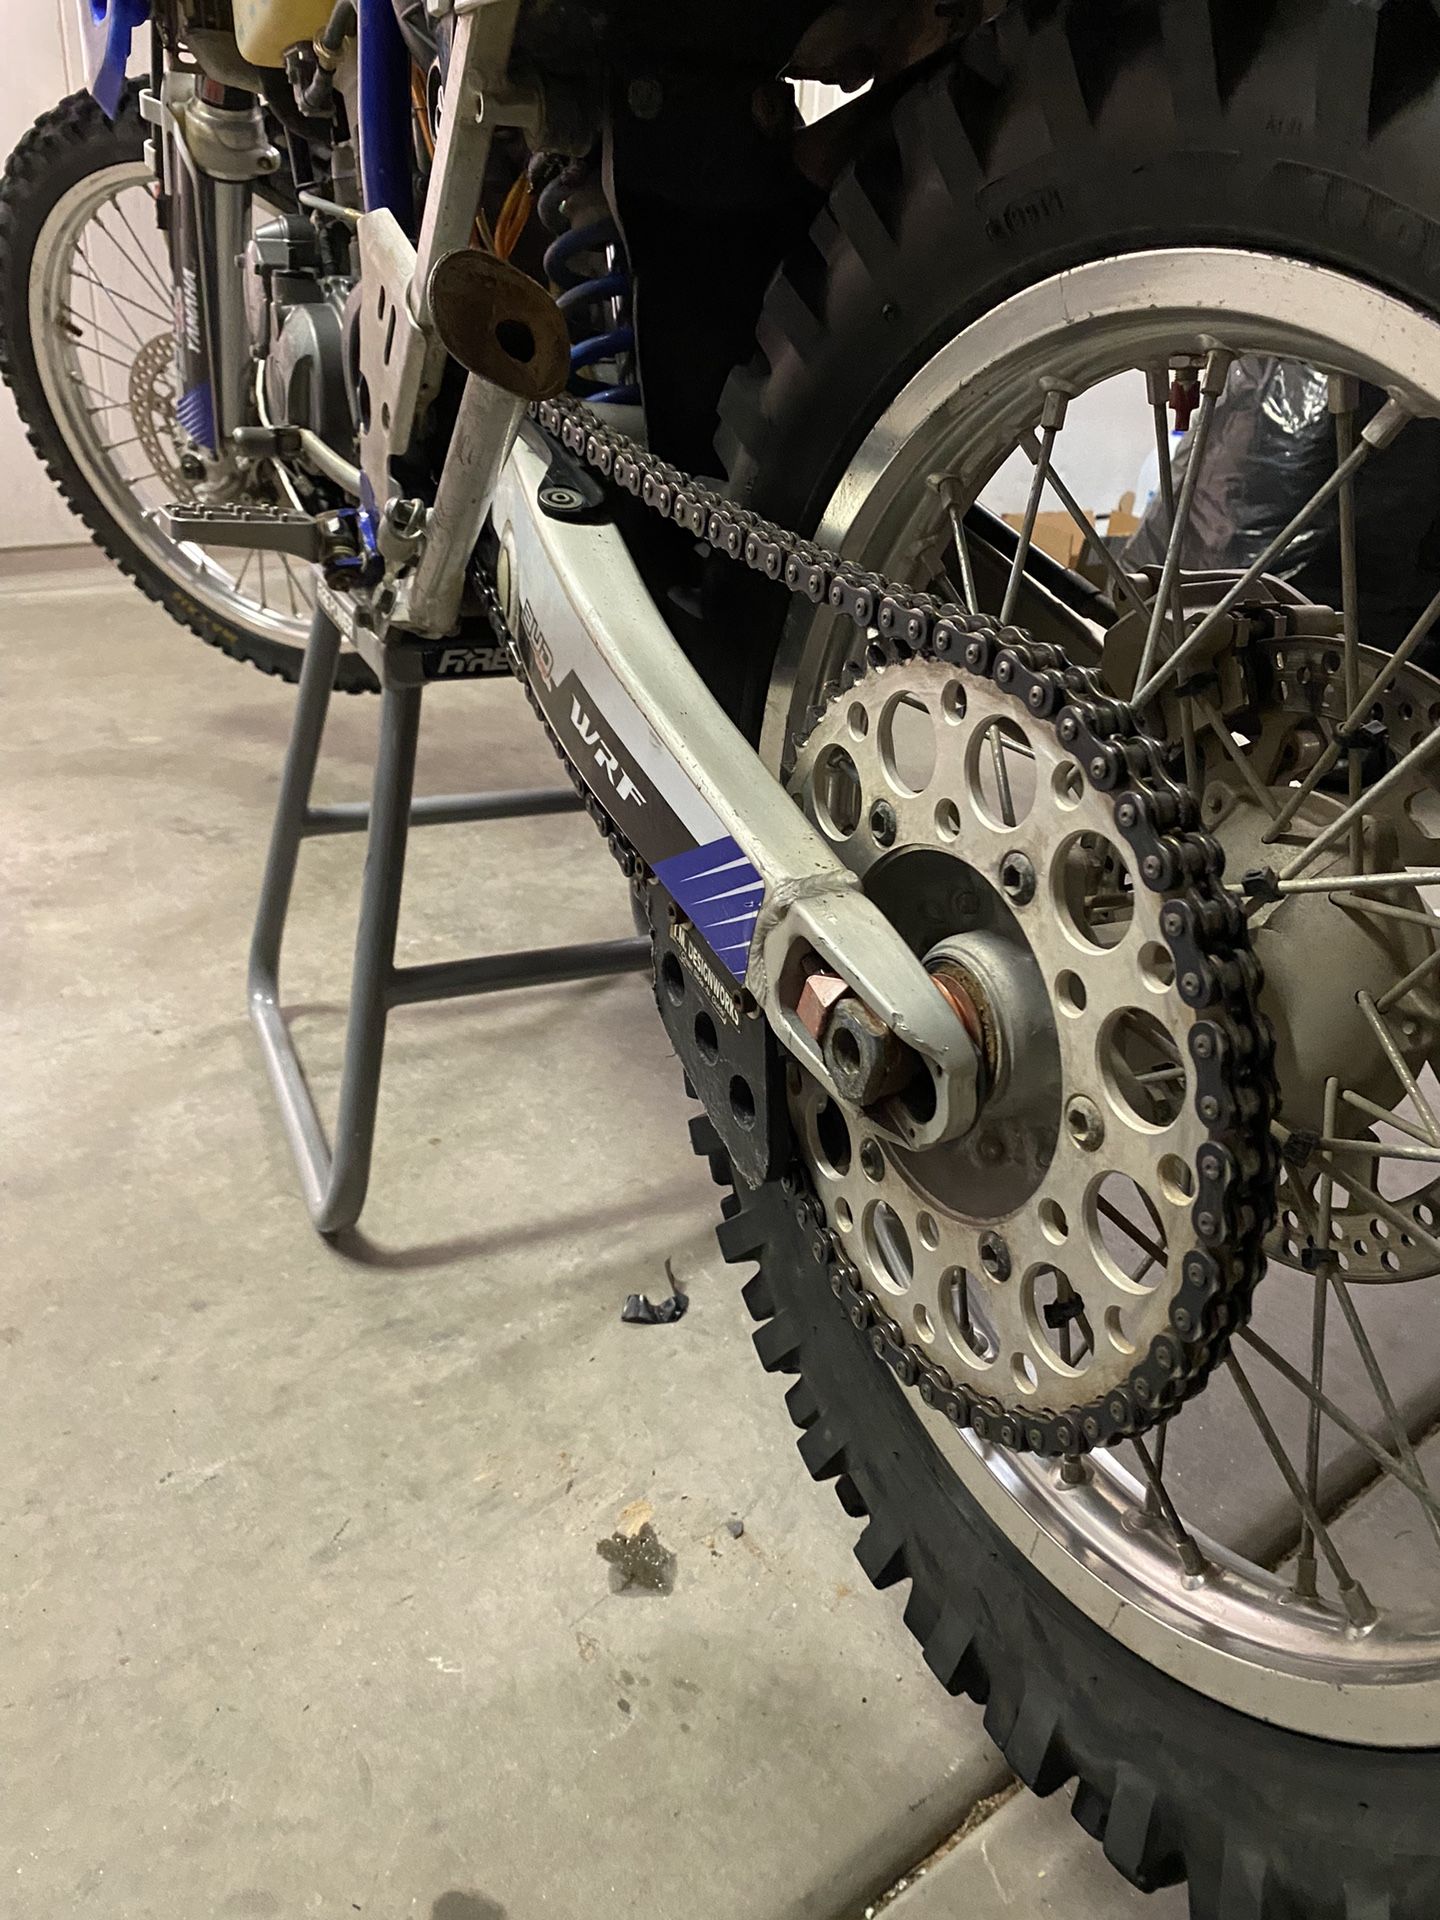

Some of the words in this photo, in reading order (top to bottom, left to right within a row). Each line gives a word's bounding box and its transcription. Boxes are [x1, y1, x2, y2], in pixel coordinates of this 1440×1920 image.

[182, 266, 201, 354] YAMAHA
[570, 692, 647, 807] WRF
[687, 940, 740, 1026] DESIGNWORKS
